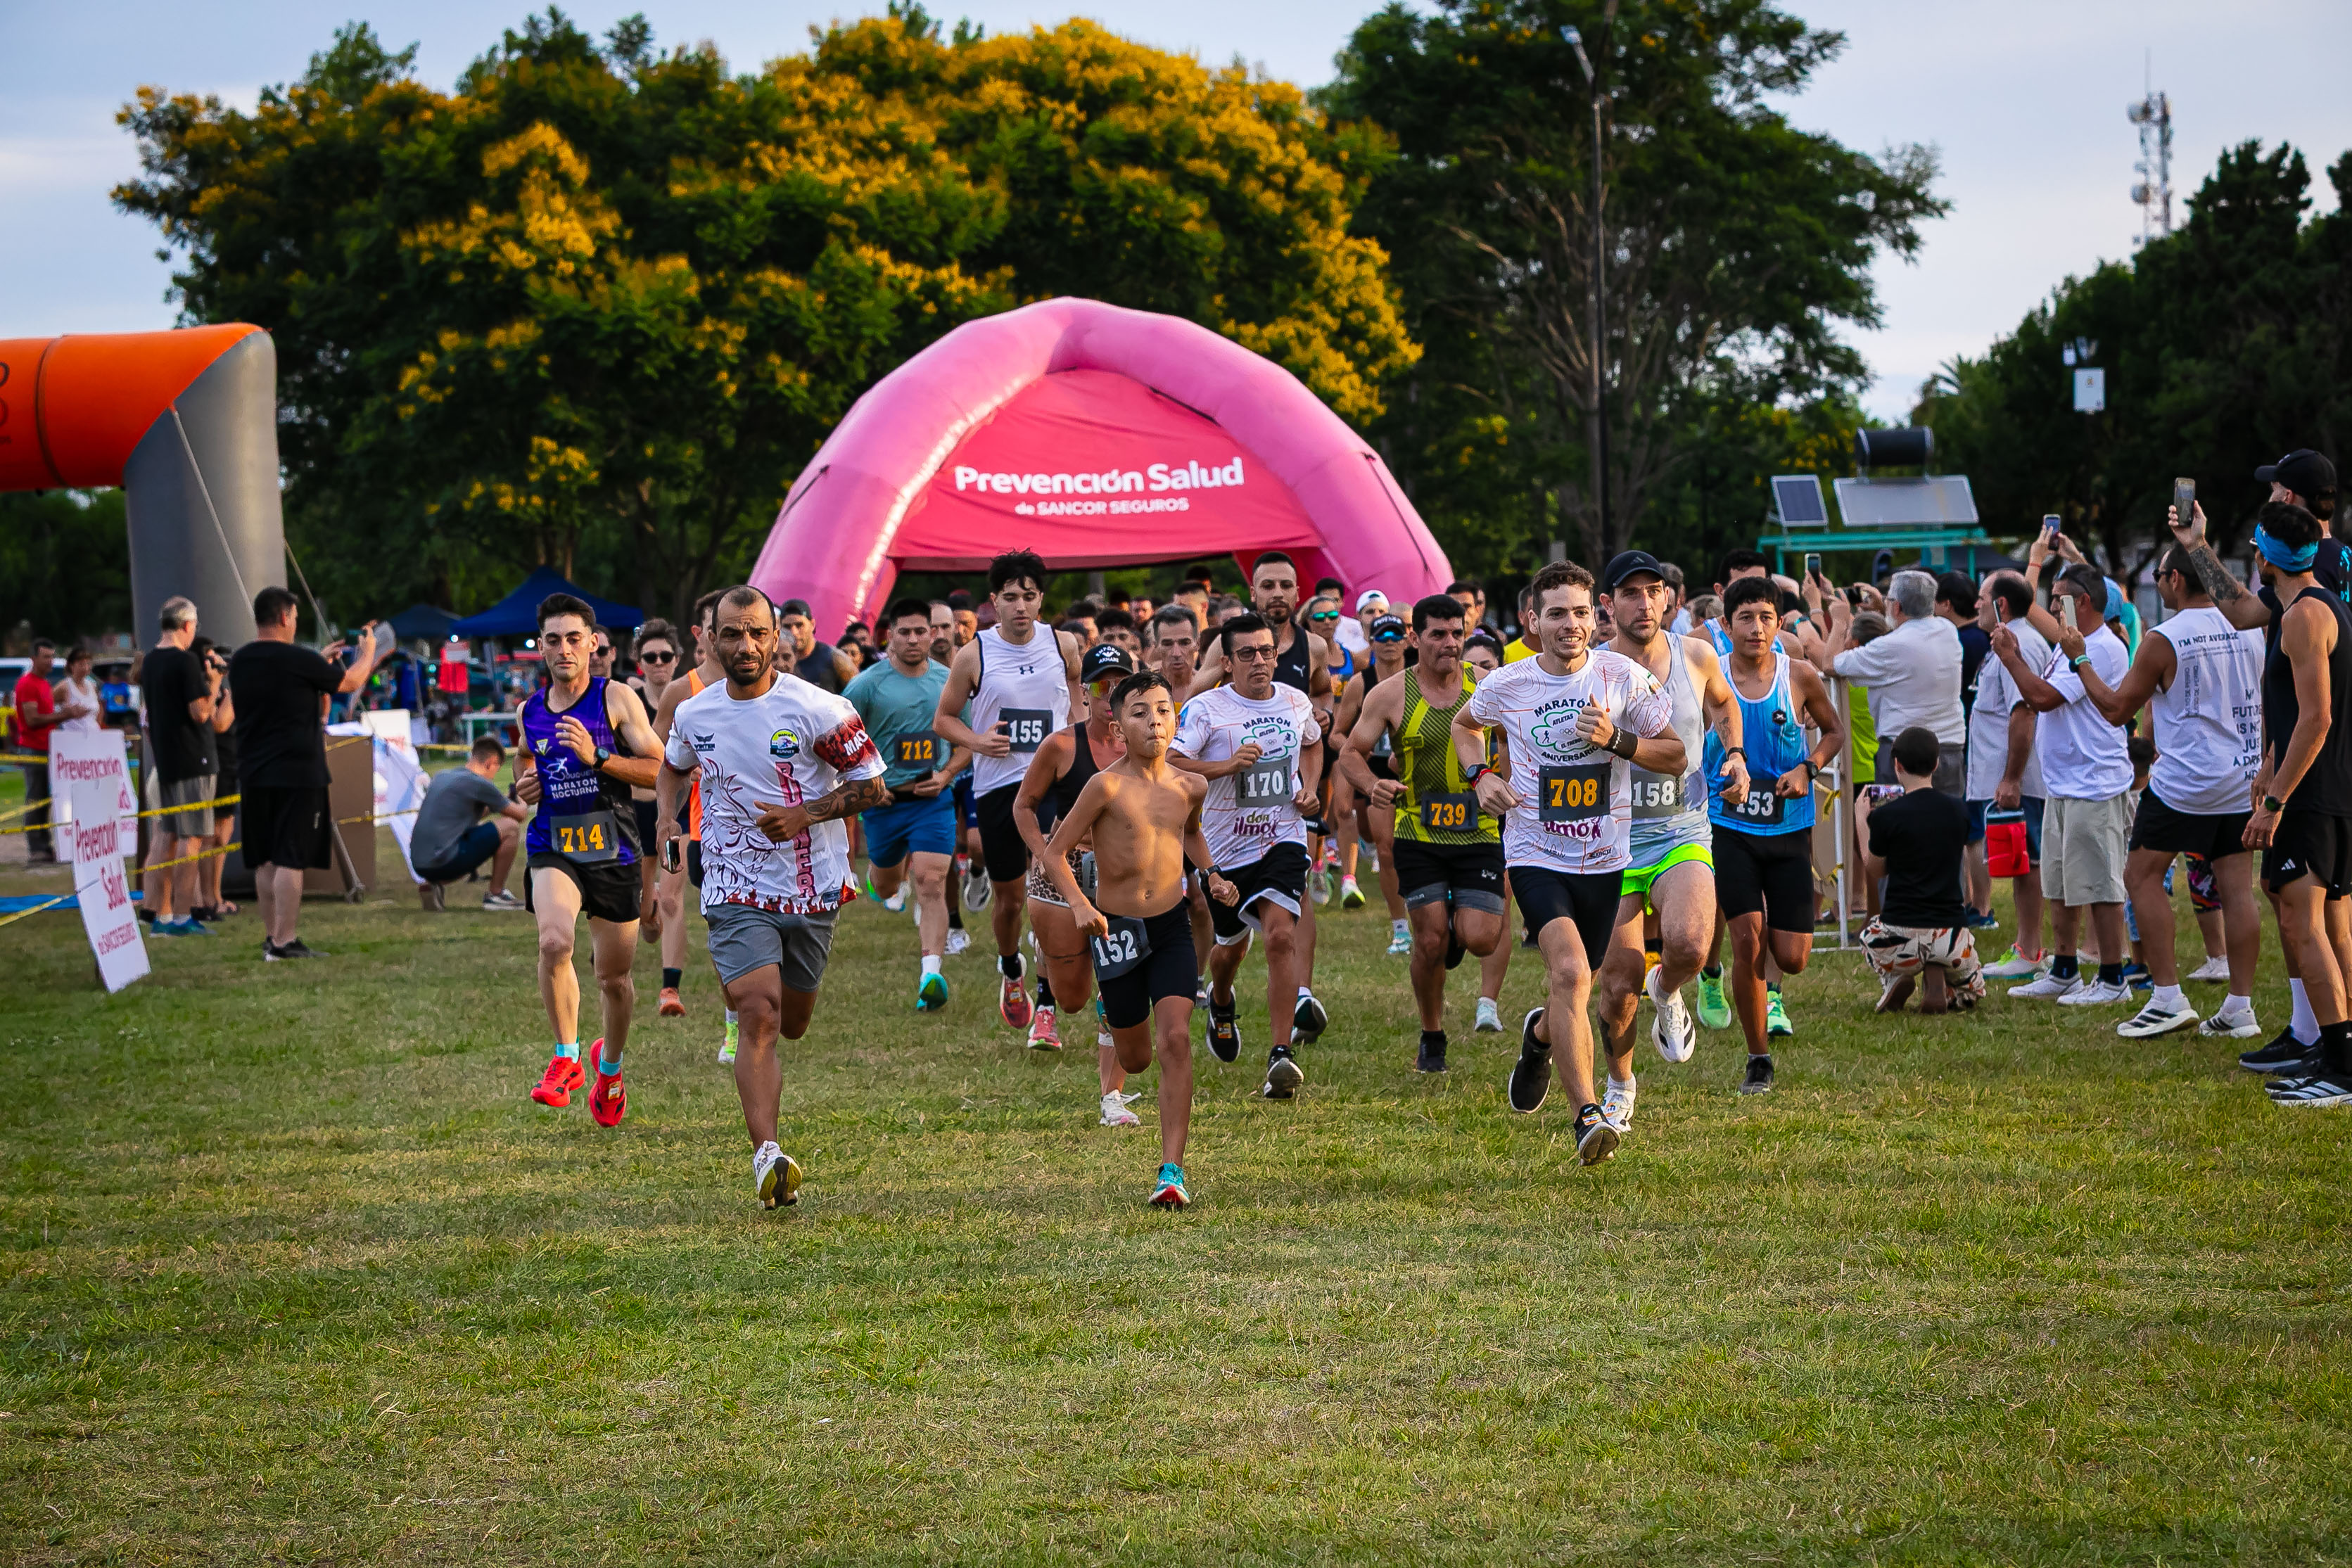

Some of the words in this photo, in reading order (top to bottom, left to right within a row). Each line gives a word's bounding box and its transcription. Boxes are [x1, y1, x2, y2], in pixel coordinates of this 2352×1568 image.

[955, 464, 1145, 495] Prevención
[1148, 456, 1245, 492] Salud
[1015, 502, 1035, 516] de
[1037, 500, 1107, 516] SANCOR
[1110, 497, 1190, 514] SEGUROS
[2178, 638, 2191, 647] I'M
[2192, 635, 2206, 643] NOT
[1534, 698, 1591, 718] MARATÓ
[1242, 717, 1290, 729] MARATÓN
[1552, 713, 1574, 726] ATLETAS
[1010, 720, 1043, 744] 155
[901, 739, 933, 760] 712
[56, 751, 124, 781] Prevención
[550, 777, 597, 792] MARATON
[552, 785, 599, 799] NOCTURNA
[1247, 770, 1283, 797] 170
[1549, 779, 1598, 807] 708
[1633, 780, 1674, 807] 158
[1246, 810, 1269, 824] don
[1431, 803, 1466, 826] 739
[561, 824, 604, 853] 714
[1095, 930, 1138, 967] 152
